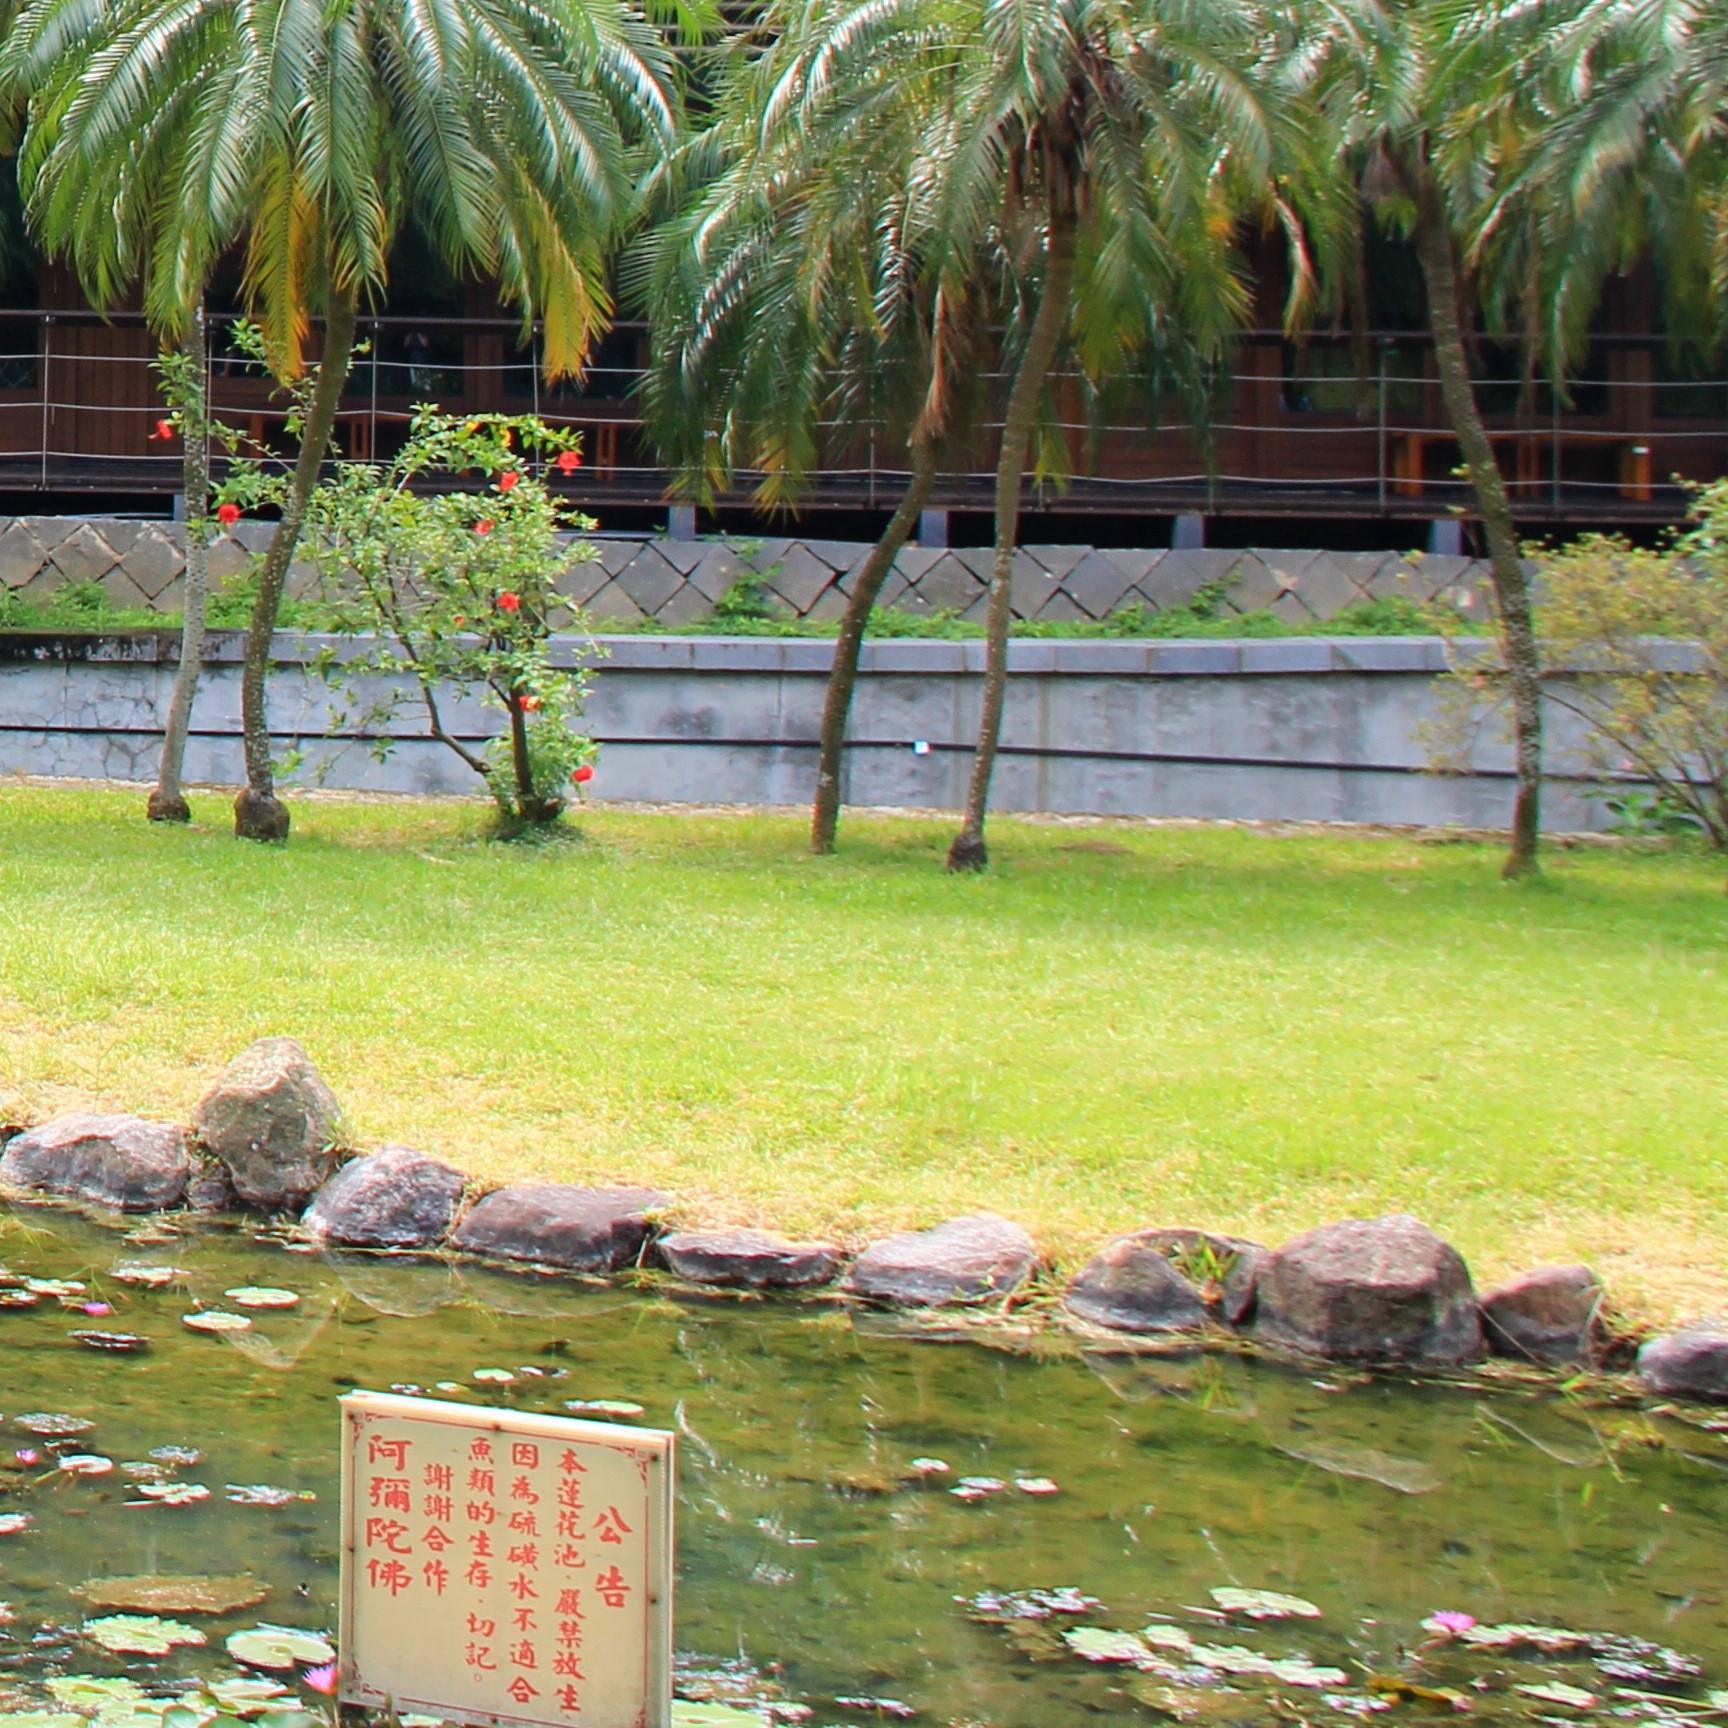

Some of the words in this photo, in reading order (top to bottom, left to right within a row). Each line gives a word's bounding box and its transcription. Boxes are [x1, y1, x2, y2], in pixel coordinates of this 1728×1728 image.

[365, 1434, 413, 1598] 阿彌陀佛
[421, 1462, 455, 1597] 謝謝合作
[592, 1504, 633, 1608] 公告
